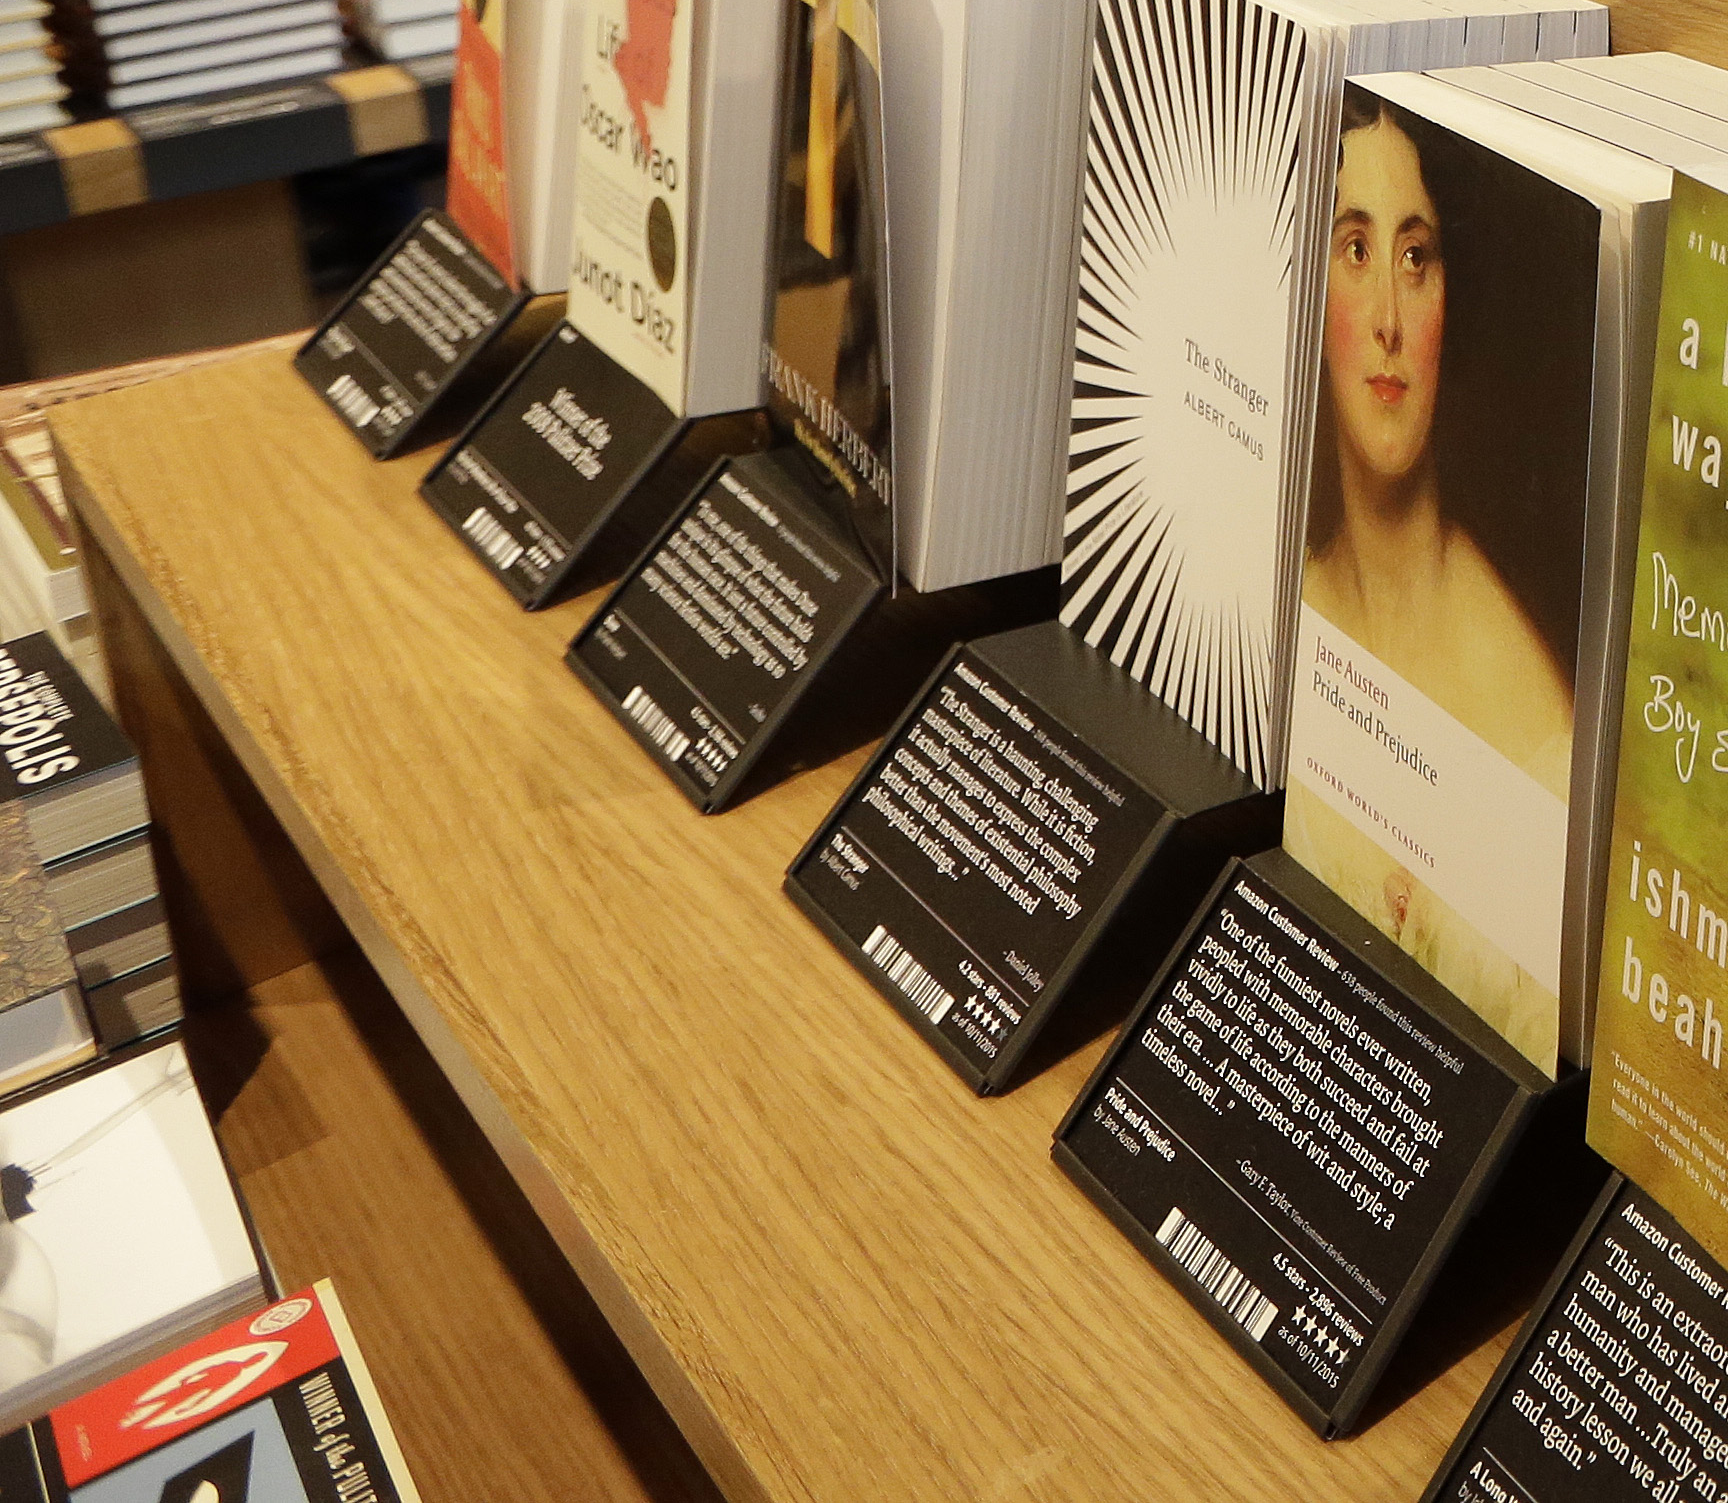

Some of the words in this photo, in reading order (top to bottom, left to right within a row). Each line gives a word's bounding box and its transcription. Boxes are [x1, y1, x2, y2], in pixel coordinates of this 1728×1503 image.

[629, 115, 680, 192] Wao
[1687, 230, 1703, 253] #1
[1184, 337, 1210, 374] The
[1212, 356, 1269, 417] Stranger
[1678, 316, 1700, 370] a
[760, 343, 820, 424] FRANK
[820, 397, 892, 506] HERBERT
[1183, 390, 1226, 429] ALBERT
[1227, 419, 1264, 461] CAMUS
[1314, 635, 1343, 674] Jane
[1342, 659, 1389, 710] Austen
[953, 701, 994, 741] Stranger
[987, 728, 1002, 748] is
[995, 739, 1008, 753] a
[1042, 776, 1099, 834] challenging
[1312, 669, 1346, 713] Pride
[1346, 703, 1373, 735] and
[1374, 717, 1438, 786] Prejudice
[1642, 673, 1701, 781] Boy
[1306, 756, 1344, 793] OXFORD
[1390, 824, 1435, 868] CLASSICS
[1219, 907, 1245, 943] "One
[1241, 934, 1262, 953] of
[1253, 940, 1276, 969] the
[1270, 955, 1323, 1009] funniest
[1317, 998, 1360, 1039] novels
[1355, 1030, 1387, 1061] ever
[1383, 1051, 1431, 1107] written,
[1620, 935, 1723, 1070] beah
[1140, 1026, 1188, 1078] timeless
[1103, 1086, 1127, 1115] Pride
[1122, 1107, 1144, 1129] and
[1137, 1118, 1176, 1162] Prejudice
[1603, 1236, 1641, 1286] "This
[1635, 1270, 1655, 1300] is
[1650, 1290, 1674, 1320] an
[1620, 1202, 1669, 1252] Amazon
[1667, 1242, 1724, 1299] Customer
[1562, 1291, 1639, 1377] humanity
[1633, 1366, 1671, 1406] and
[1579, 1269, 1617, 1312] man
[1615, 1300, 1650, 1340] who
[1645, 1324, 1679, 1367] has
[1673, 1349, 1720, 1404] lived
[299, 1371, 347, 1435] WINNER
[313, 1433, 351, 1452] of
[1510, 1388, 1547, 1427] and
[1538, 1416, 1597, 1471] again."
[1527, 1350, 1585, 1420] history
[1578, 1401, 1630, 1466] lesson
[1628, 1453, 1655, 1489] we
[1546, 1328, 1561, 1349] a
[1559, 1330, 1607, 1391] better
[1598, 1378, 1640, 1427] man
[1691, 1469, 1720, 1503] an
[325, 1442, 356, 1471] the
